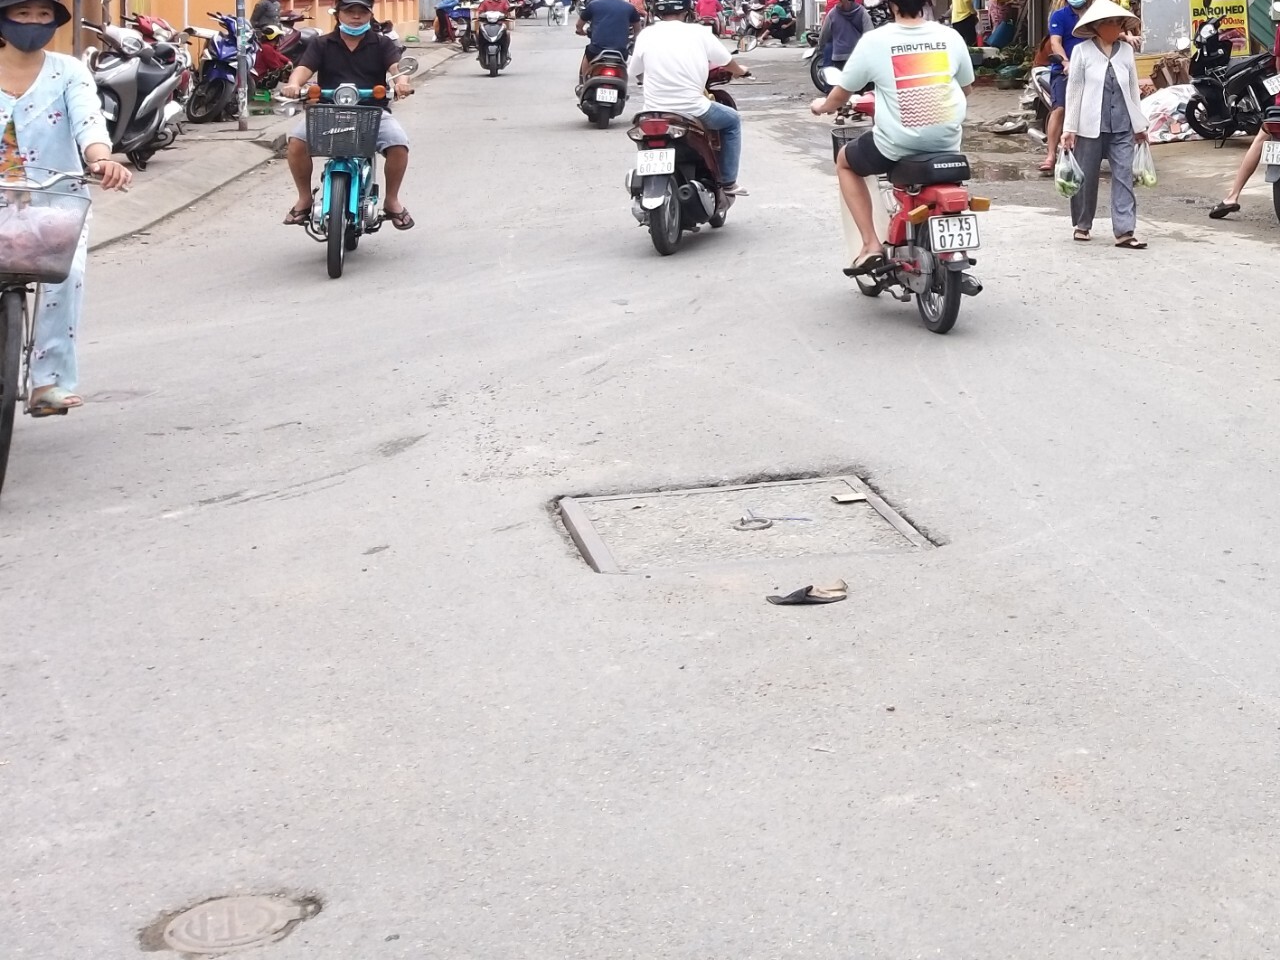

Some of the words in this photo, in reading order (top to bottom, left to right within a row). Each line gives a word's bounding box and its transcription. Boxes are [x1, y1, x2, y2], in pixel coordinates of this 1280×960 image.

[1225, 5, 1244, 14] HEO
[891, 41, 947, 54] FAIRYTALES
[933, 161, 968, 169] HONDA
[940, 233, 972, 249] 0737
